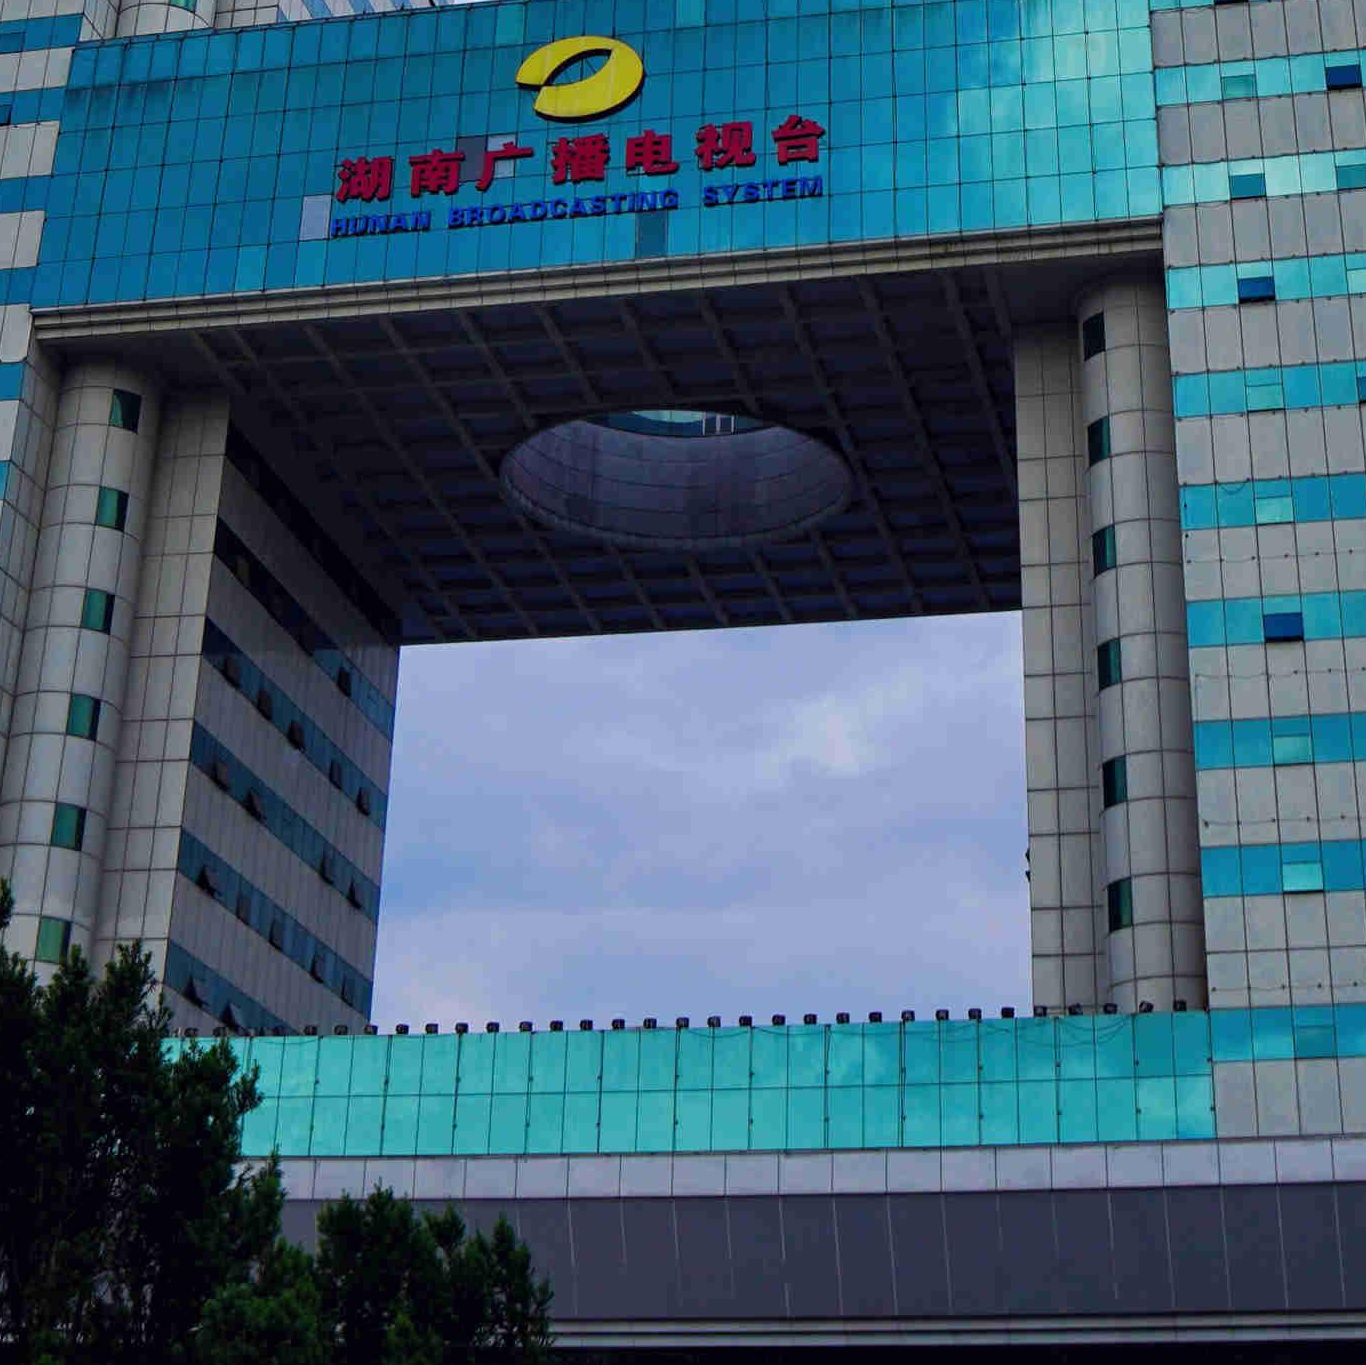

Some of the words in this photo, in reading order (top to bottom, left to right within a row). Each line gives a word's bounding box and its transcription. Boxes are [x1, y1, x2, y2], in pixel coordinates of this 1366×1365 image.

[336, 115, 826, 203] 湖南广播电视台
[331, 211, 430, 236] HUNAN
[447, 190, 680, 229] BROADCASTING
[701, 176, 823, 207] SYSTEM
